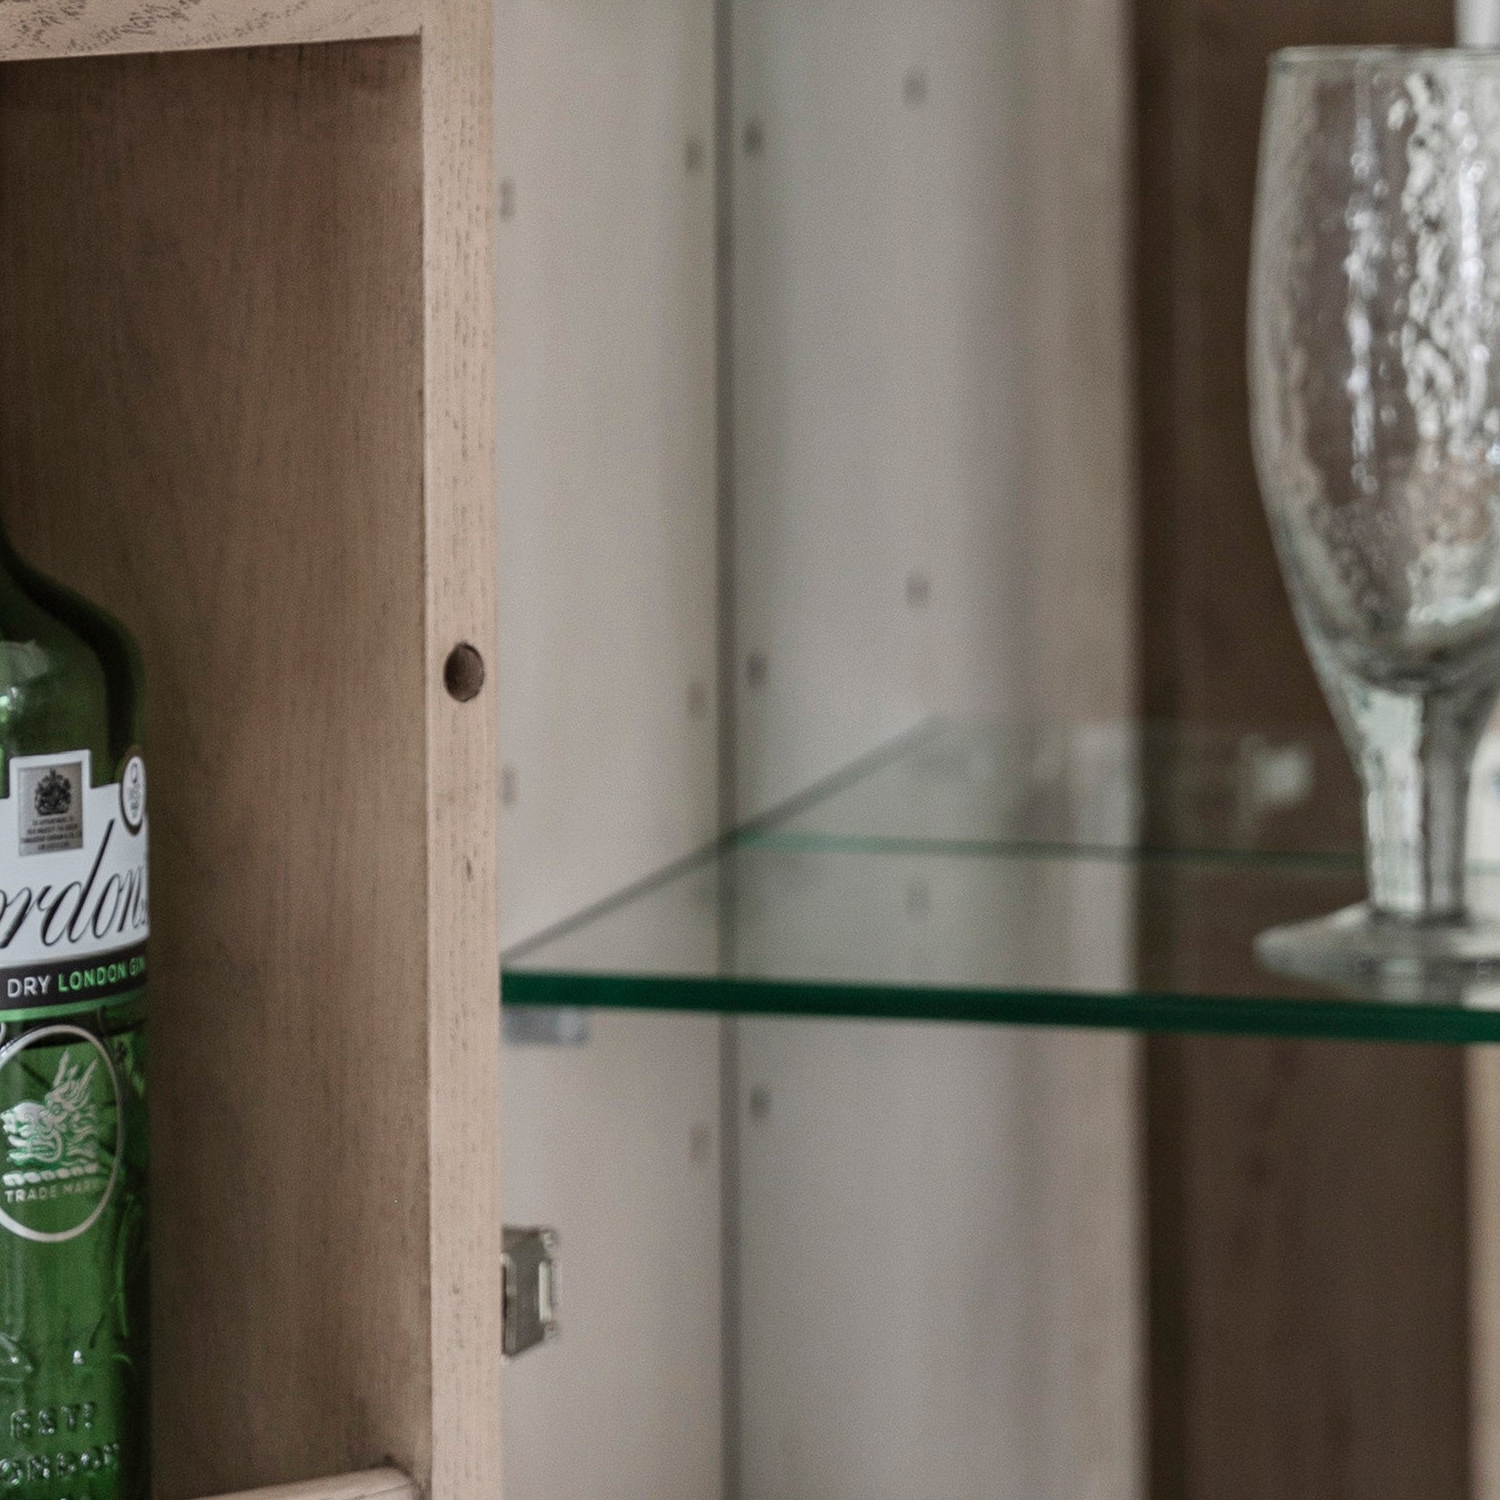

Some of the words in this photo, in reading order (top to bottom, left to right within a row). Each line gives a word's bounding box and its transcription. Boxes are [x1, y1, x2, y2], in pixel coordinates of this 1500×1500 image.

[7, 975, 51, 998] DRY
[58, 962, 127, 992] LONDON
[4, 1185, 57, 1204] TRADE
